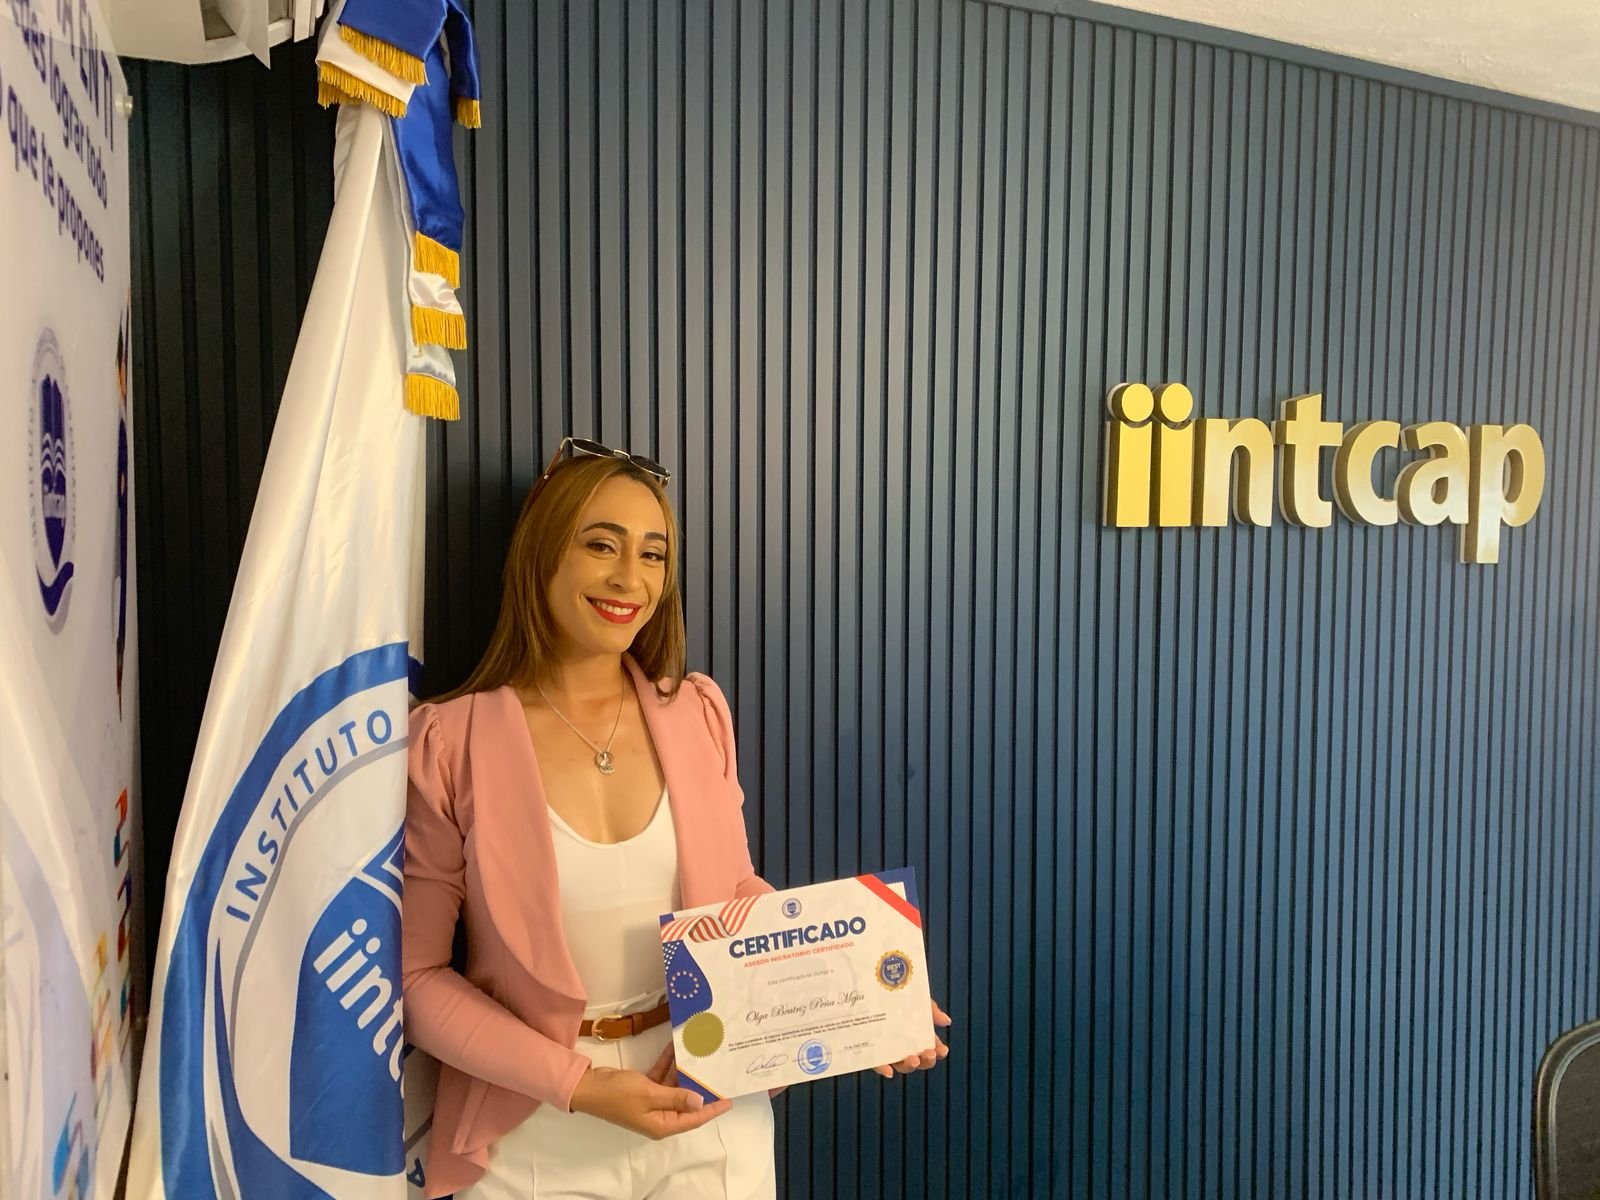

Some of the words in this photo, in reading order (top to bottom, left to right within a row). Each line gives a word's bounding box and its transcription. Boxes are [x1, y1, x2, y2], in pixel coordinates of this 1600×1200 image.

[8, 85, 38, 181] que
[41, 132, 54, 208] te
[57, 172, 104, 283] propones
[49, 28, 85, 163] lograr
[86, 125, 107, 209] todo
[1103, 382, 1546, 564] iintcap
[226, 708, 393, 922] INSTITUTO
[729, 916, 866, 958] CERTIFICADO
[744, 959, 770, 968] ASESOR
[812, 941, 855, 954] CERTIFICADO
[745, 1010, 768, 1025] Olga
[771, 1004, 806, 1017] Beatriz
